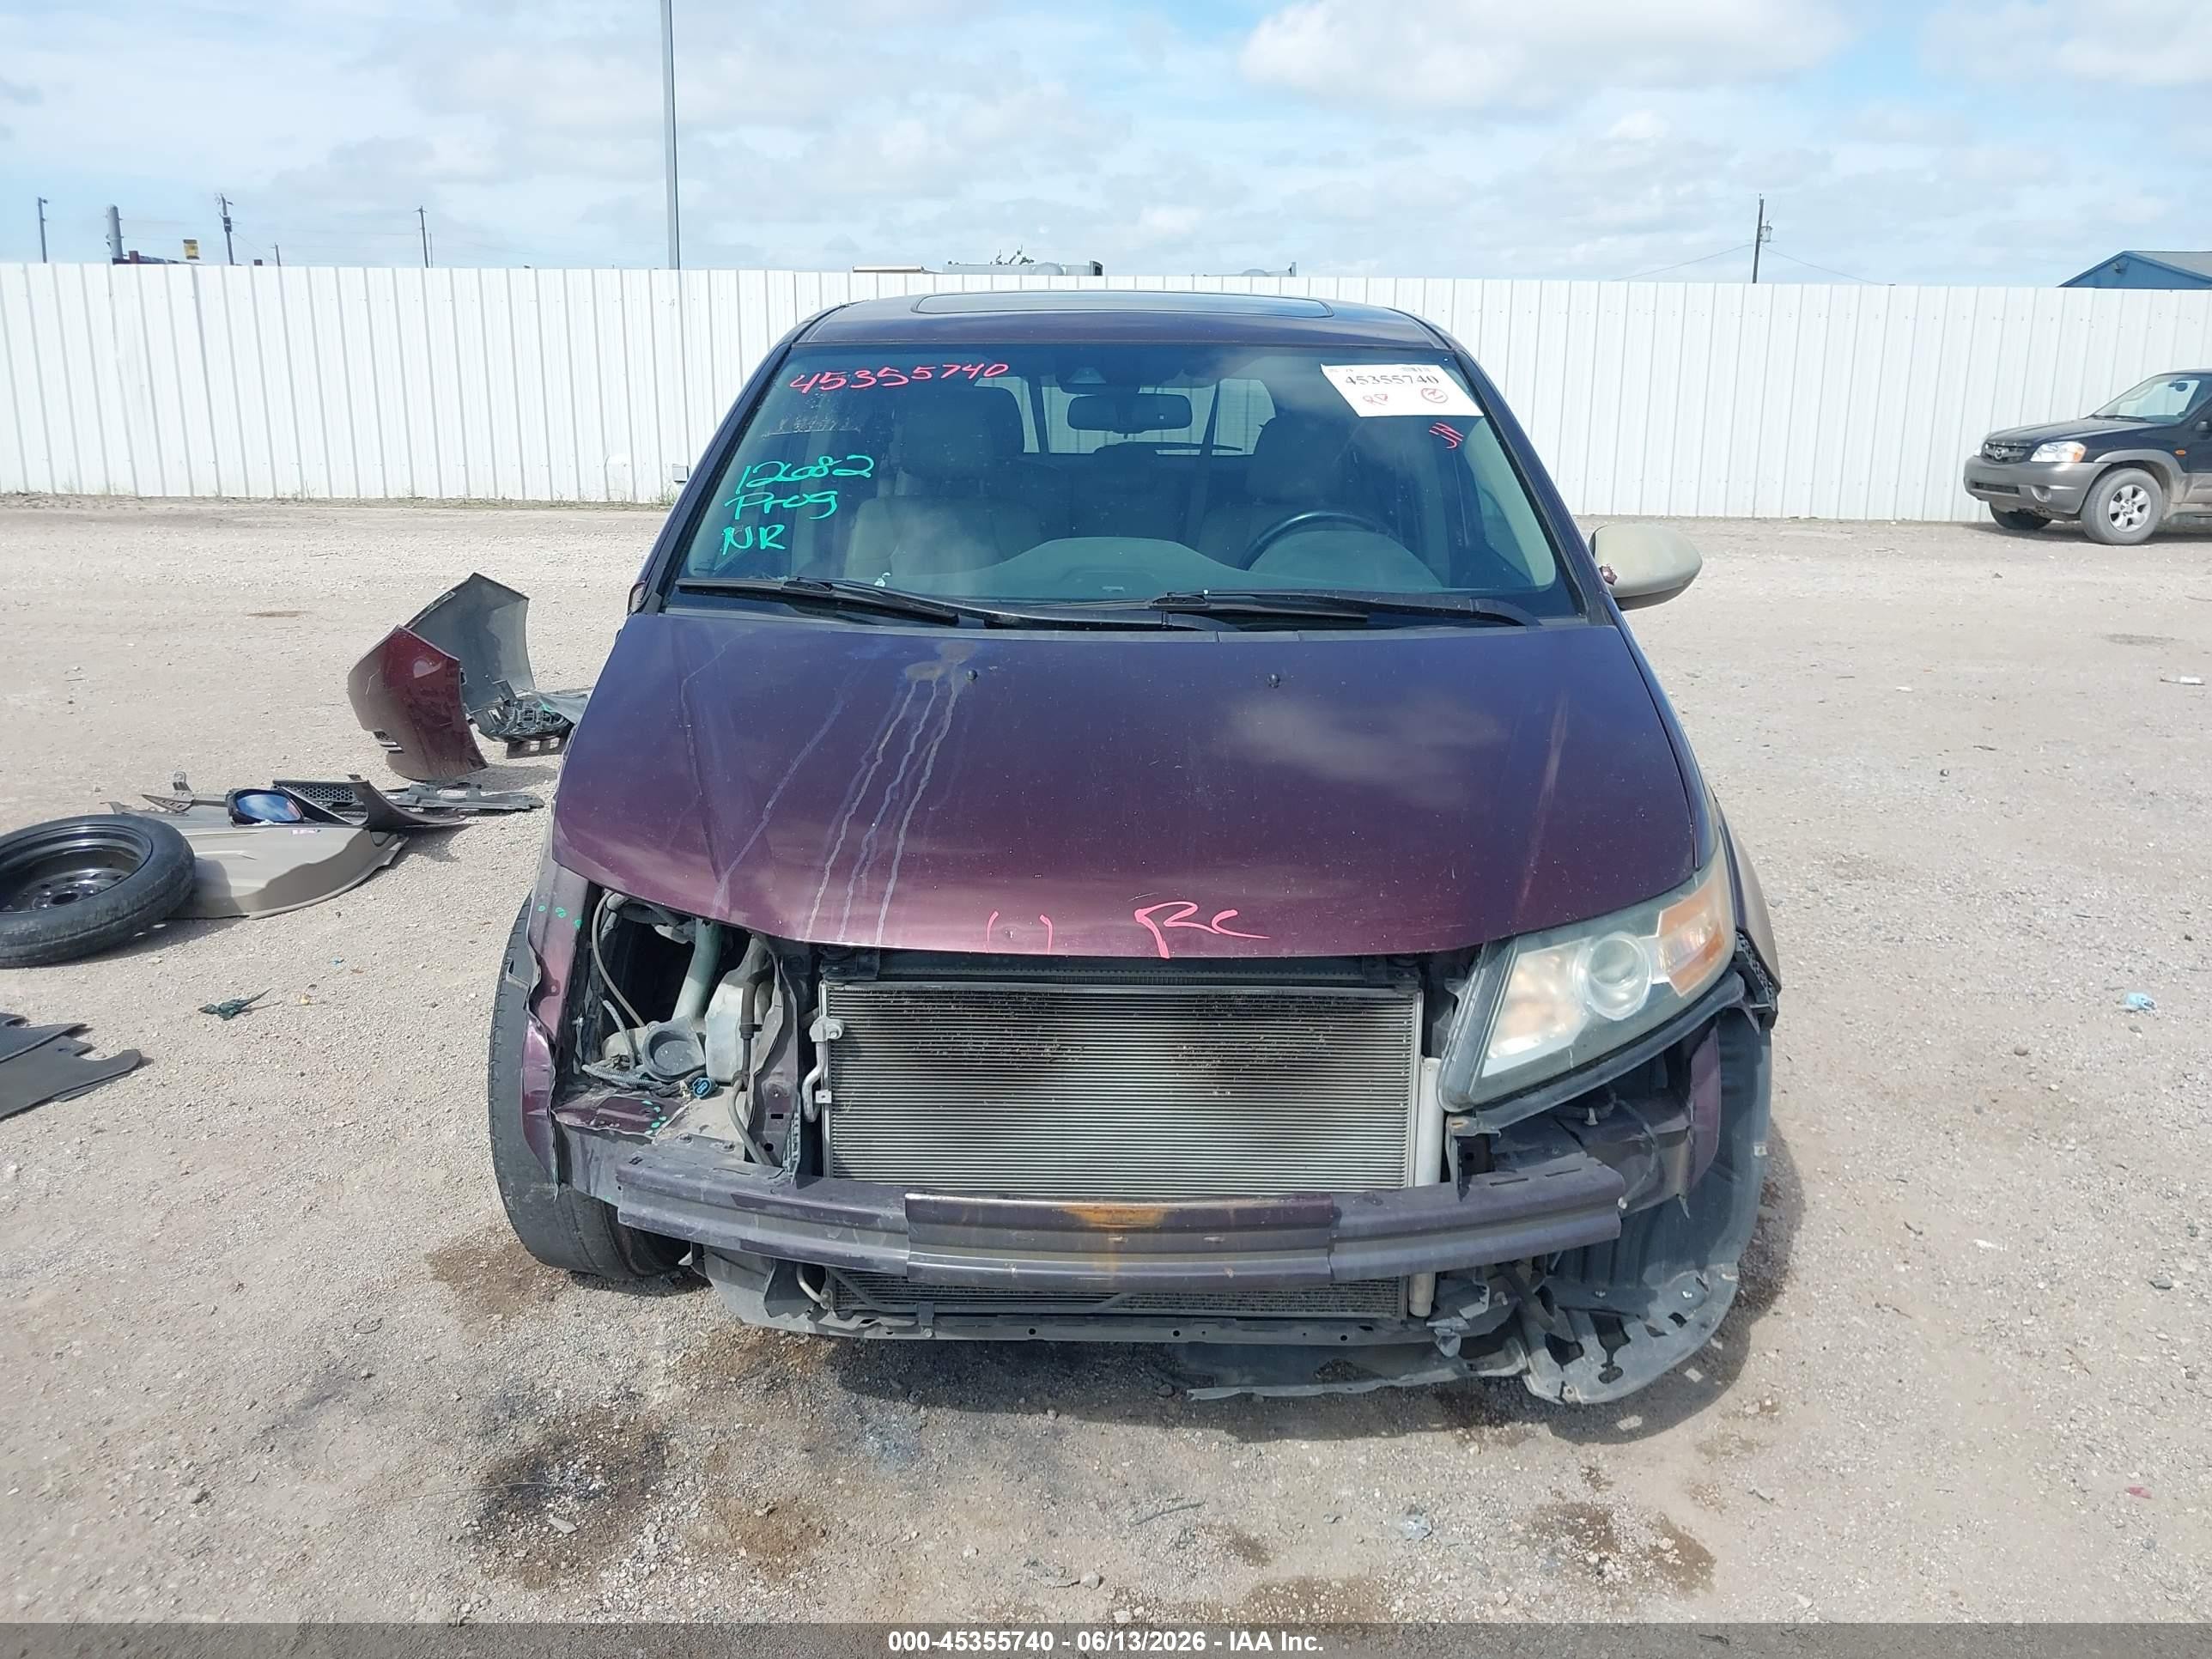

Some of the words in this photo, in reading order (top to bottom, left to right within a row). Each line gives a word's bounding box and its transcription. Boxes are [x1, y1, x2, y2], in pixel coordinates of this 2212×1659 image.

[789, 362, 1011, 394] 45355740
[1345, 374, 1440, 386] 45355740
[721, 524, 787, 556] NR
